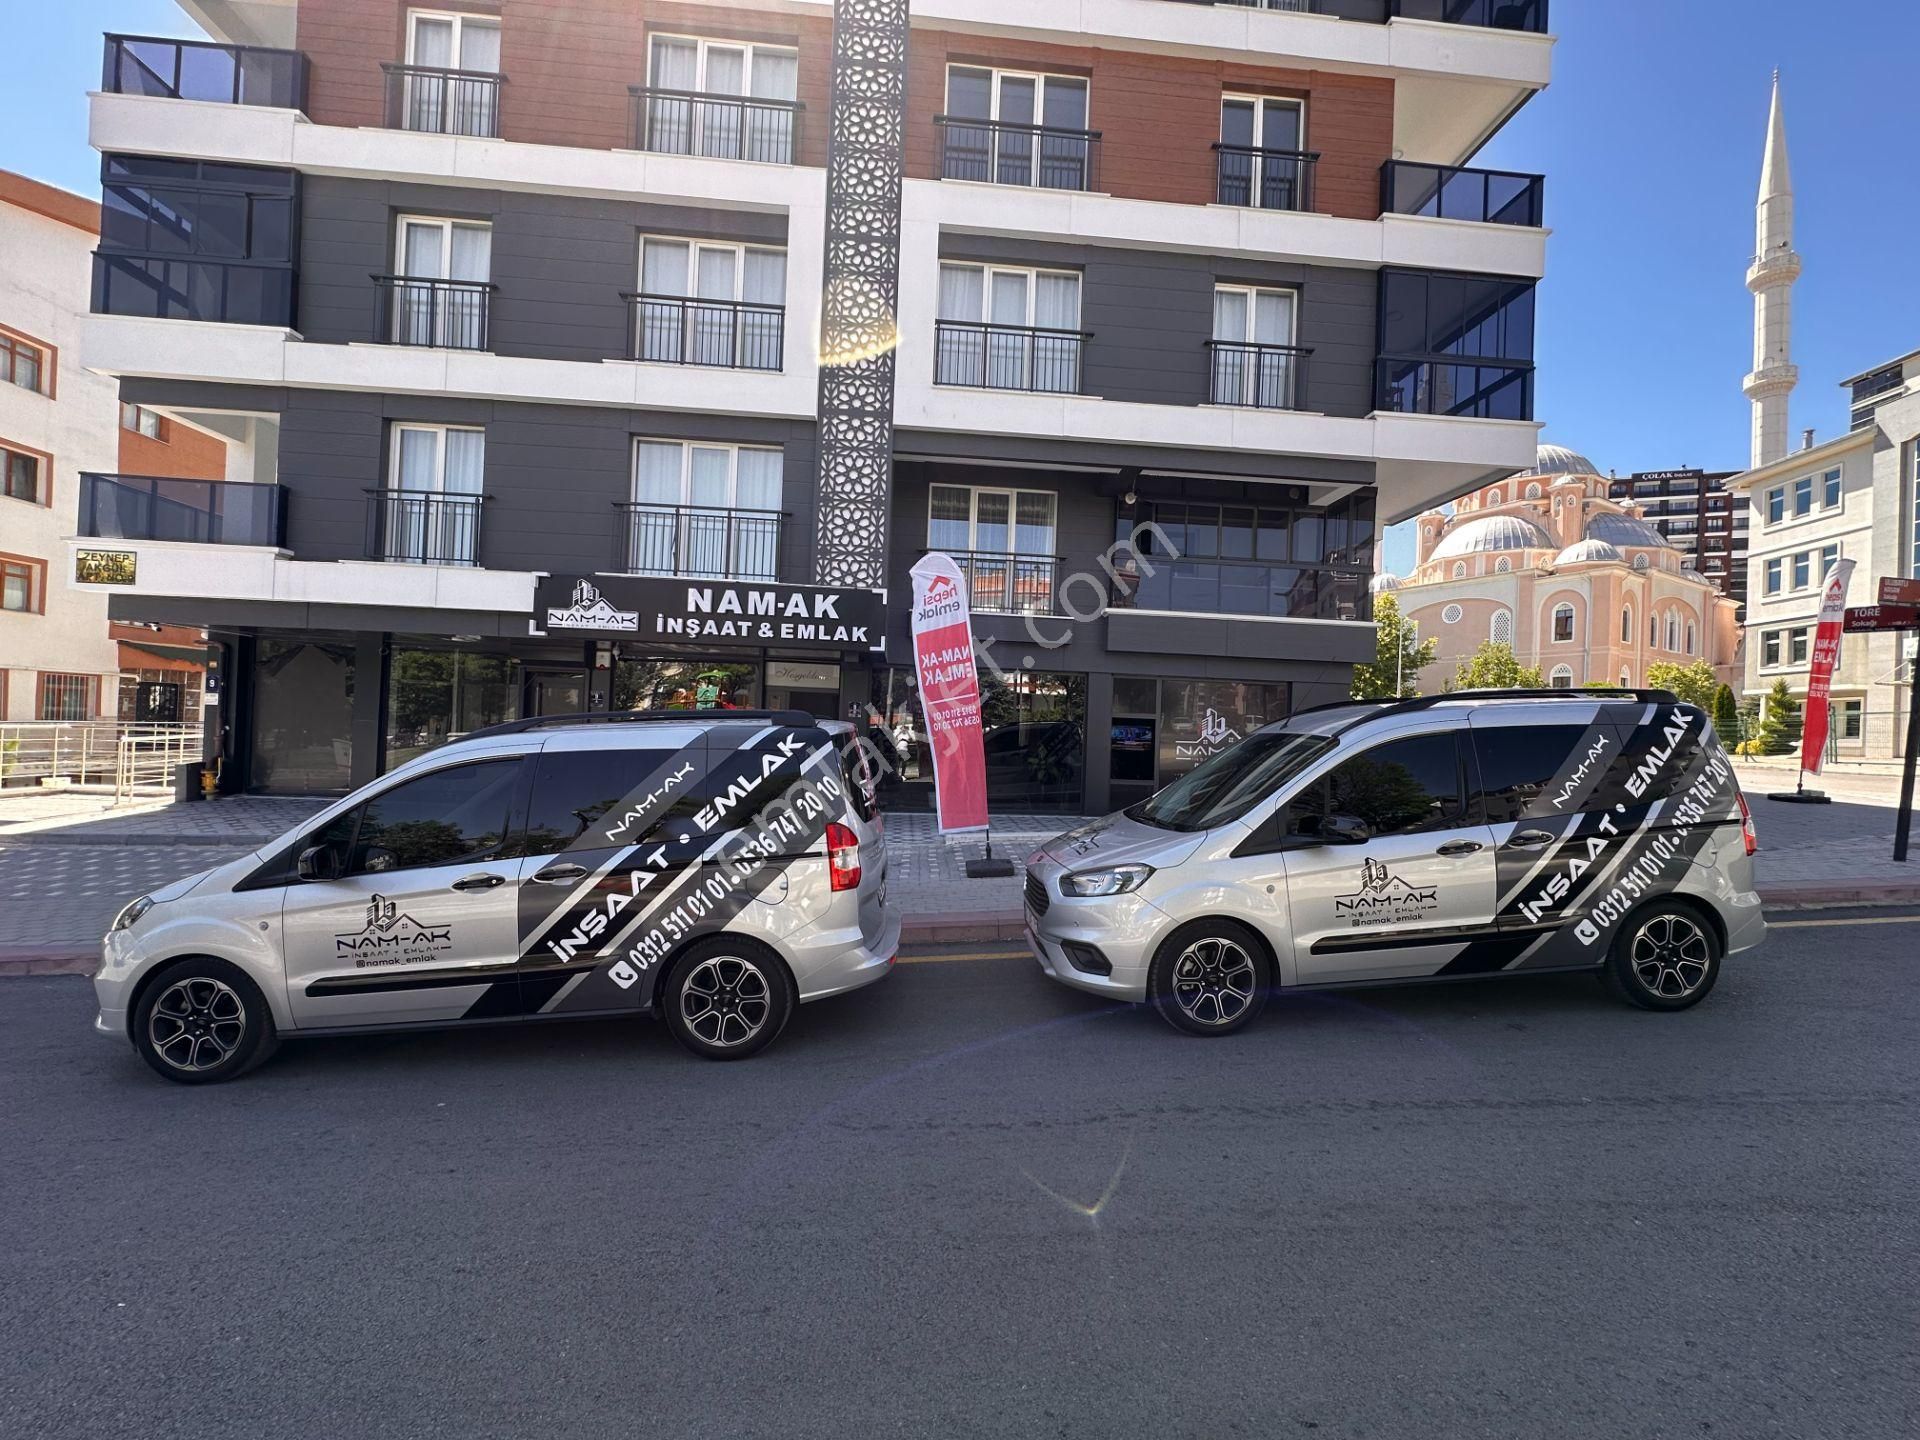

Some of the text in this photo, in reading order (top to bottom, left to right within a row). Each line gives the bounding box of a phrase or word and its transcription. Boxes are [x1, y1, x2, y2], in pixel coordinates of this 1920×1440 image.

[1641, 472, 1673, 480] ÇOLAK
[81, 552, 130, 563] ZEYNEP
[687, 587, 840, 619] NAM-AK
[548, 613, 636, 625] NAM-AK
[656, 613, 868, 643] İNŞAAT & EMLAK
[209, 679, 215, 688] 9
[1623, 707, 1694, 799] EMLAK
[692, 732, 806, 832] EMLAK
[1552, 734, 1609, 808] NAM-AK
[605, 761, 695, 842] NAM-AK
[1592, 888, 1633, 928] 0312
[1620, 866, 1652, 898] 511
[1639, 850, 1666, 876] 01
[1688, 774, 1717, 806] 747
[1705, 758, 1729, 785] 20
[629, 929, 672, 970] 0312
[661, 905, 695, 940] 511
[686, 889, 714, 917] 01
[768, 808, 803, 843] 747
[796, 791, 824, 820] 20
[816, 775, 841, 801] 10
[1335, 890, 1437, 911] NAM-AK
[337, 930, 451, 951] NAM-AK
[403, 946, 439, 954] EMLAK
